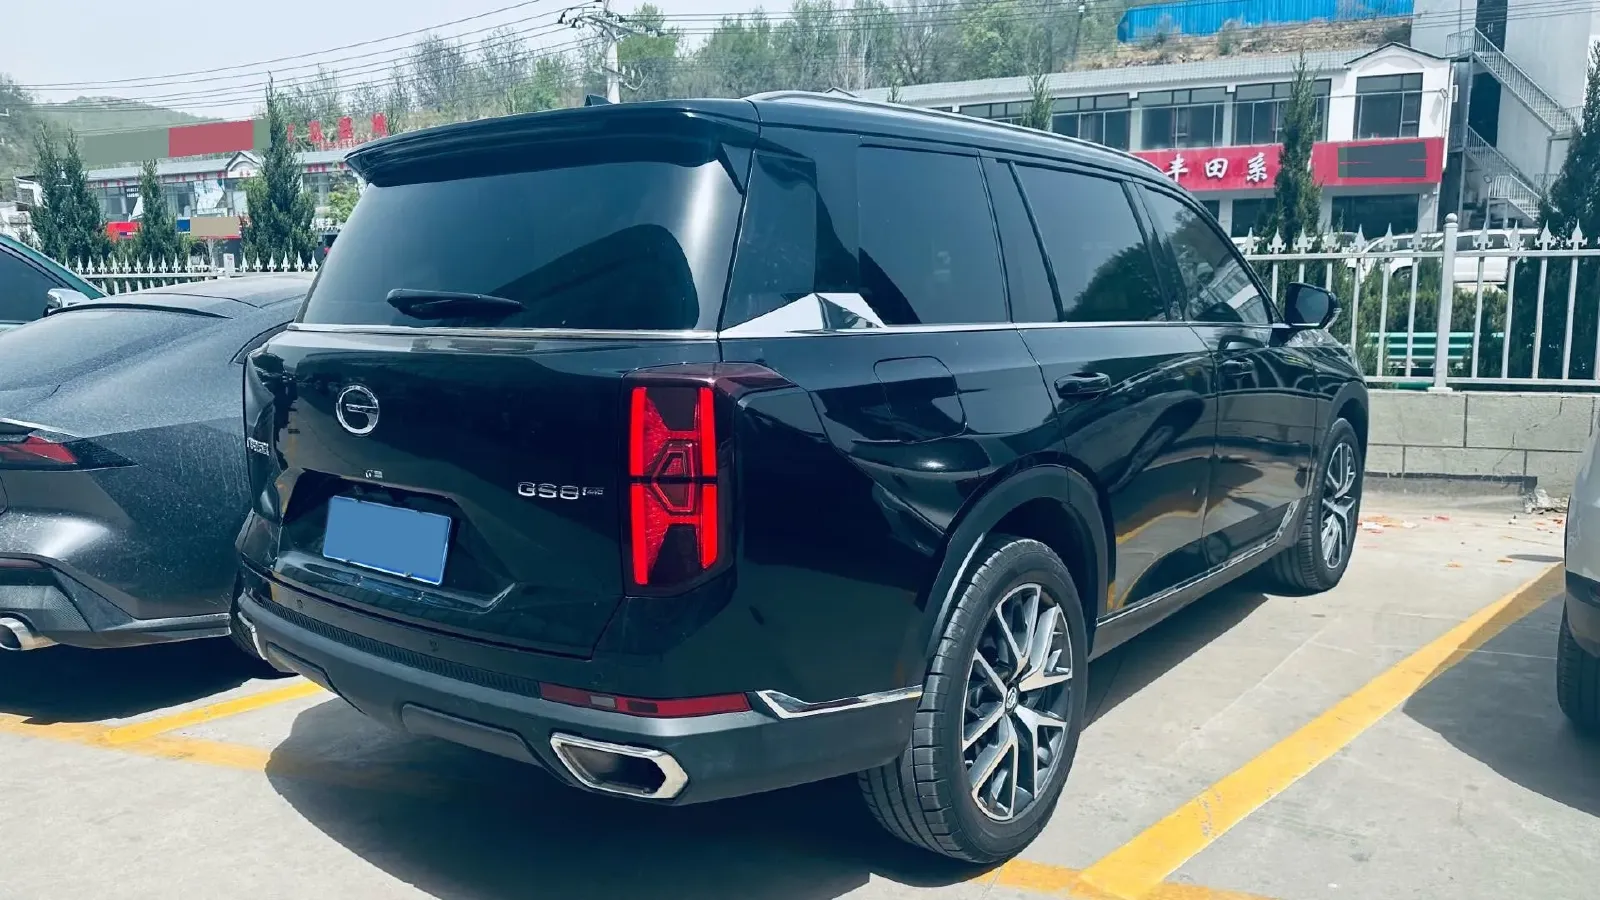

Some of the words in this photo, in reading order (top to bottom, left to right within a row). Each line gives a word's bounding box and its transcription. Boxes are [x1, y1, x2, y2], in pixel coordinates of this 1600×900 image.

[1165, 152, 1268, 183] 丰田系
[517, 481, 579, 500] GS8
